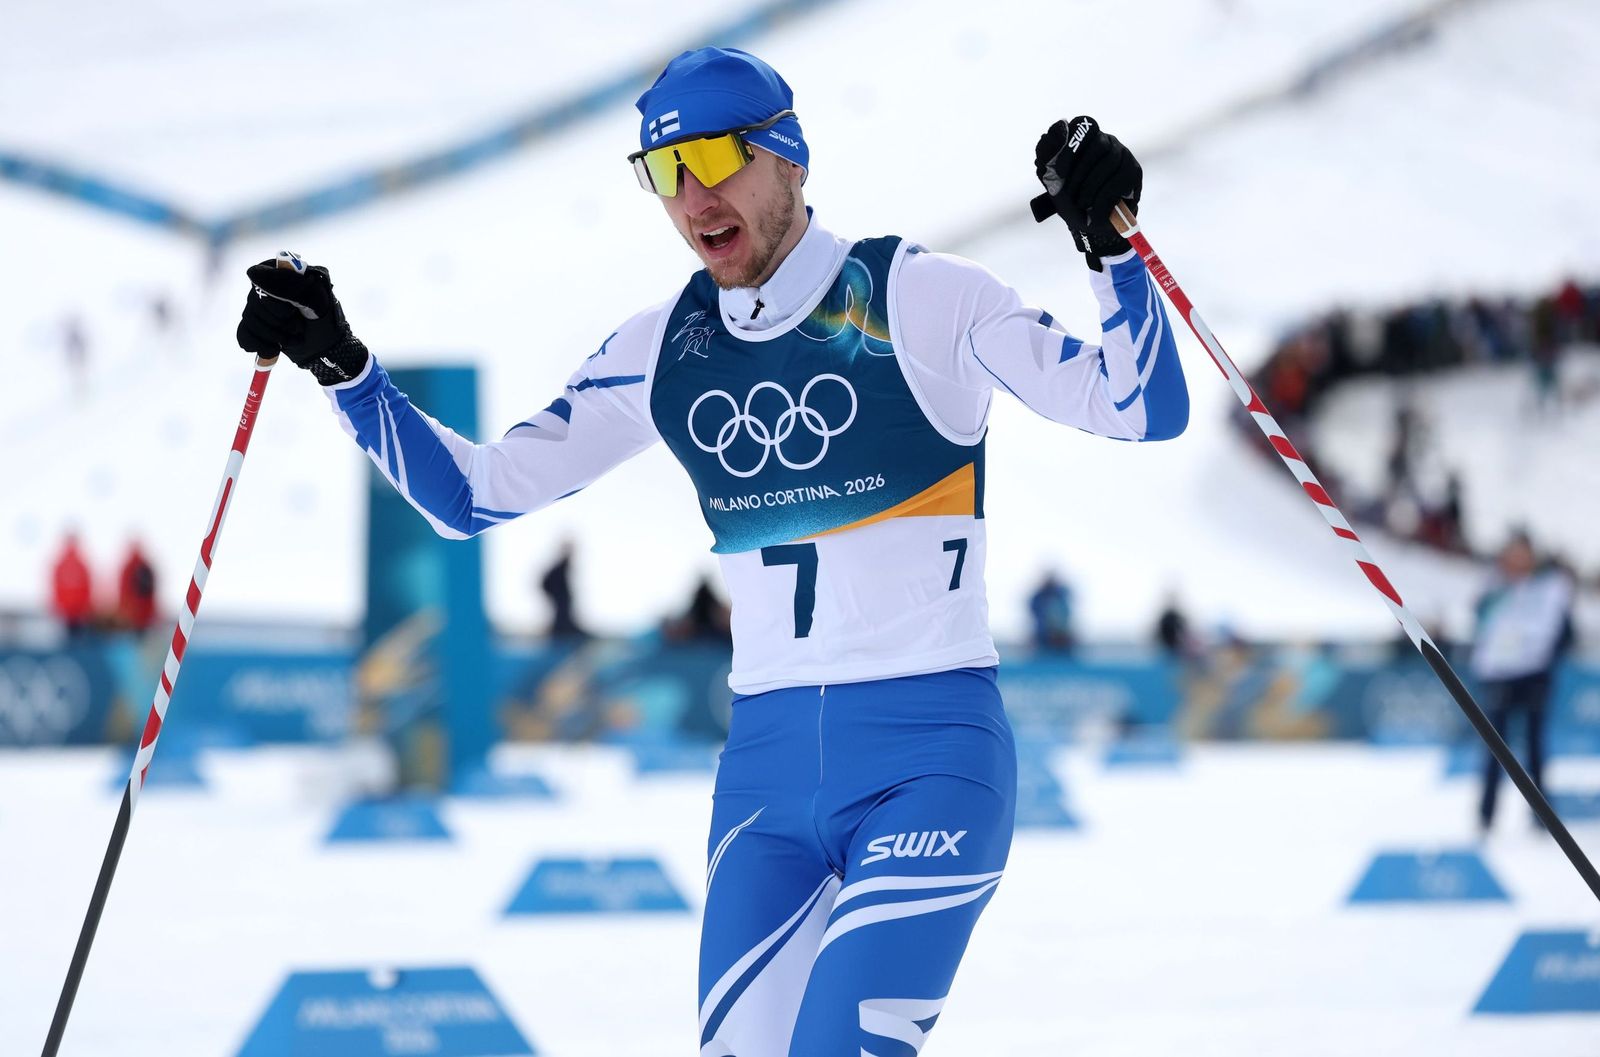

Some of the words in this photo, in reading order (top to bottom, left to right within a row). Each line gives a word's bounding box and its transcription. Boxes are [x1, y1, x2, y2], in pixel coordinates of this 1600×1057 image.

[769, 130, 799, 149] SWIX
[1068, 117, 1093, 153] SWIX
[709, 493, 762, 512] MILANO
[763, 483, 842, 507] CORTINA
[844, 473, 886, 496] 2026
[942, 537, 968, 591] 7
[760, 541, 819, 639] 7
[860, 830, 968, 867] SWIX
